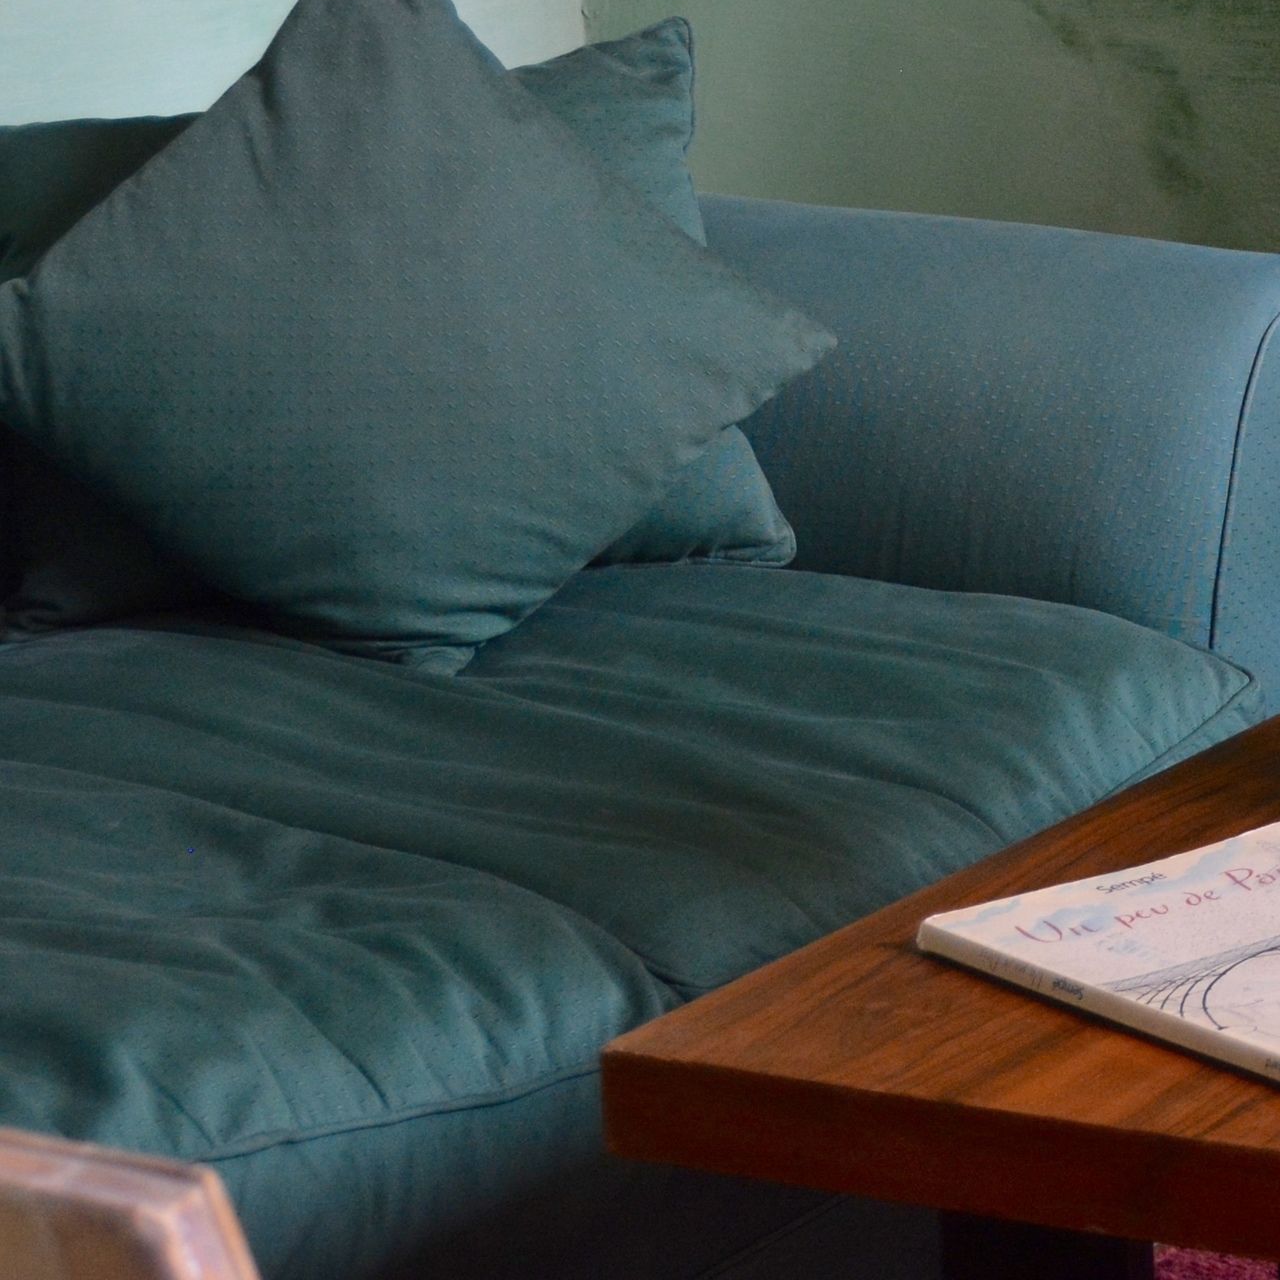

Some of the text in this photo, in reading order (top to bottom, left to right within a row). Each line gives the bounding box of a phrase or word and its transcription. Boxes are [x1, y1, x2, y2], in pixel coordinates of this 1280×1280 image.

[1096, 872, 1167, 895] Sempé
[1014, 919, 1099, 943] Un
[1114, 902, 1169, 928] peu
[1185, 888, 1220, 907] de
